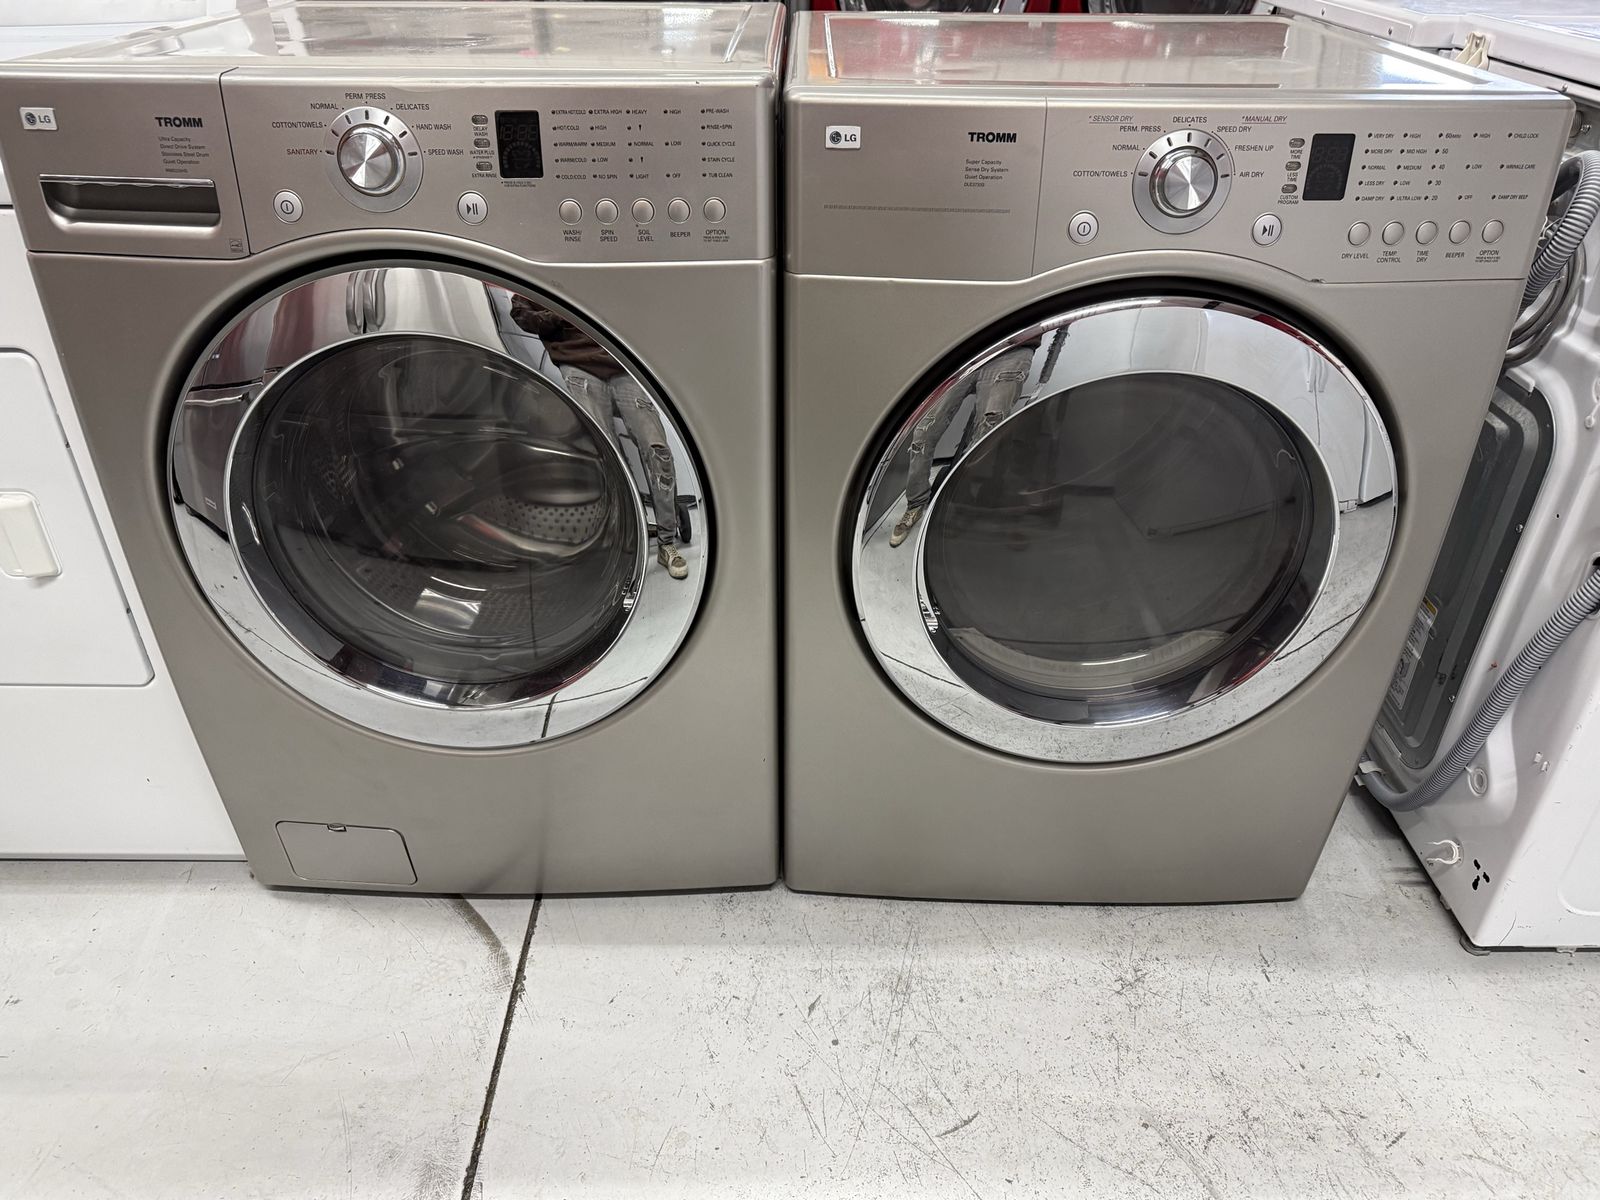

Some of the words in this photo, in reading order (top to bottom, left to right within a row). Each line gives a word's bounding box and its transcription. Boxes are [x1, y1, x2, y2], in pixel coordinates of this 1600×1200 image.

[38, 115, 51, 124] LG
[155, 117, 203, 128] TROMM
[844, 134, 857, 142] LG
[968, 132, 1017, 143] TROMM
